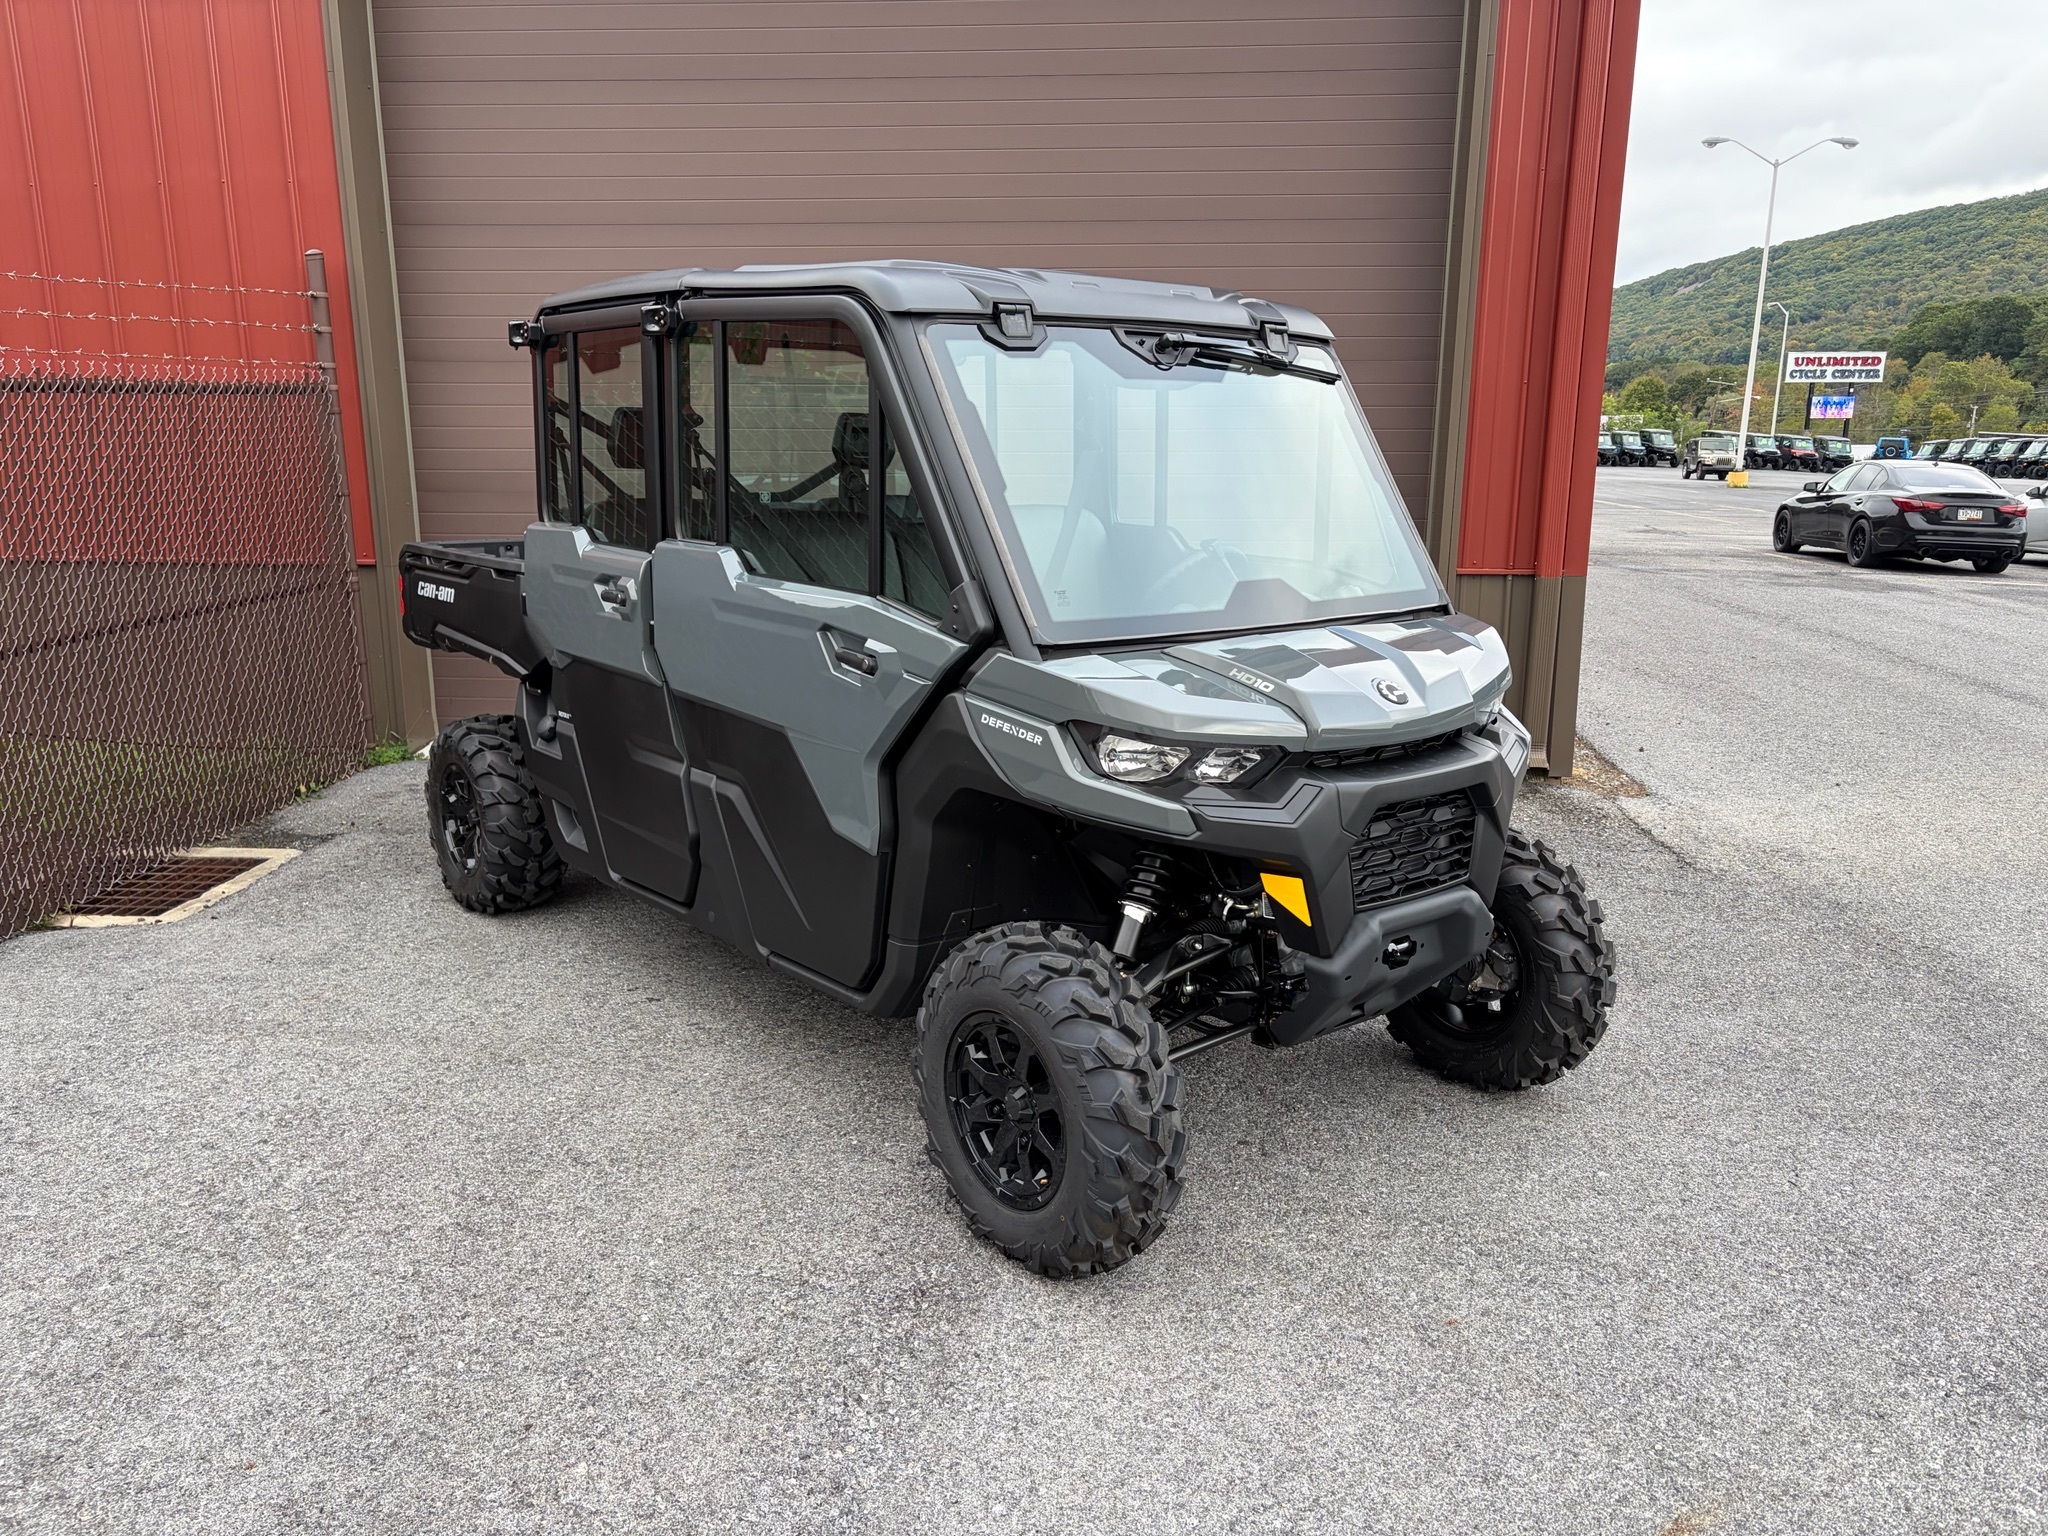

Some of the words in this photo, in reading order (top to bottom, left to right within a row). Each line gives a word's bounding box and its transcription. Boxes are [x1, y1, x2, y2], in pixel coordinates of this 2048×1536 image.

[1793, 356, 1882, 367] UNLIMITED
[1788, 368, 1828, 380] CYCLE
[1831, 369, 1881, 380] CENTER
[417, 581, 455, 603] can-am
[1228, 668, 1275, 693] HD10
[980, 713, 1043, 746] DEFENDER
